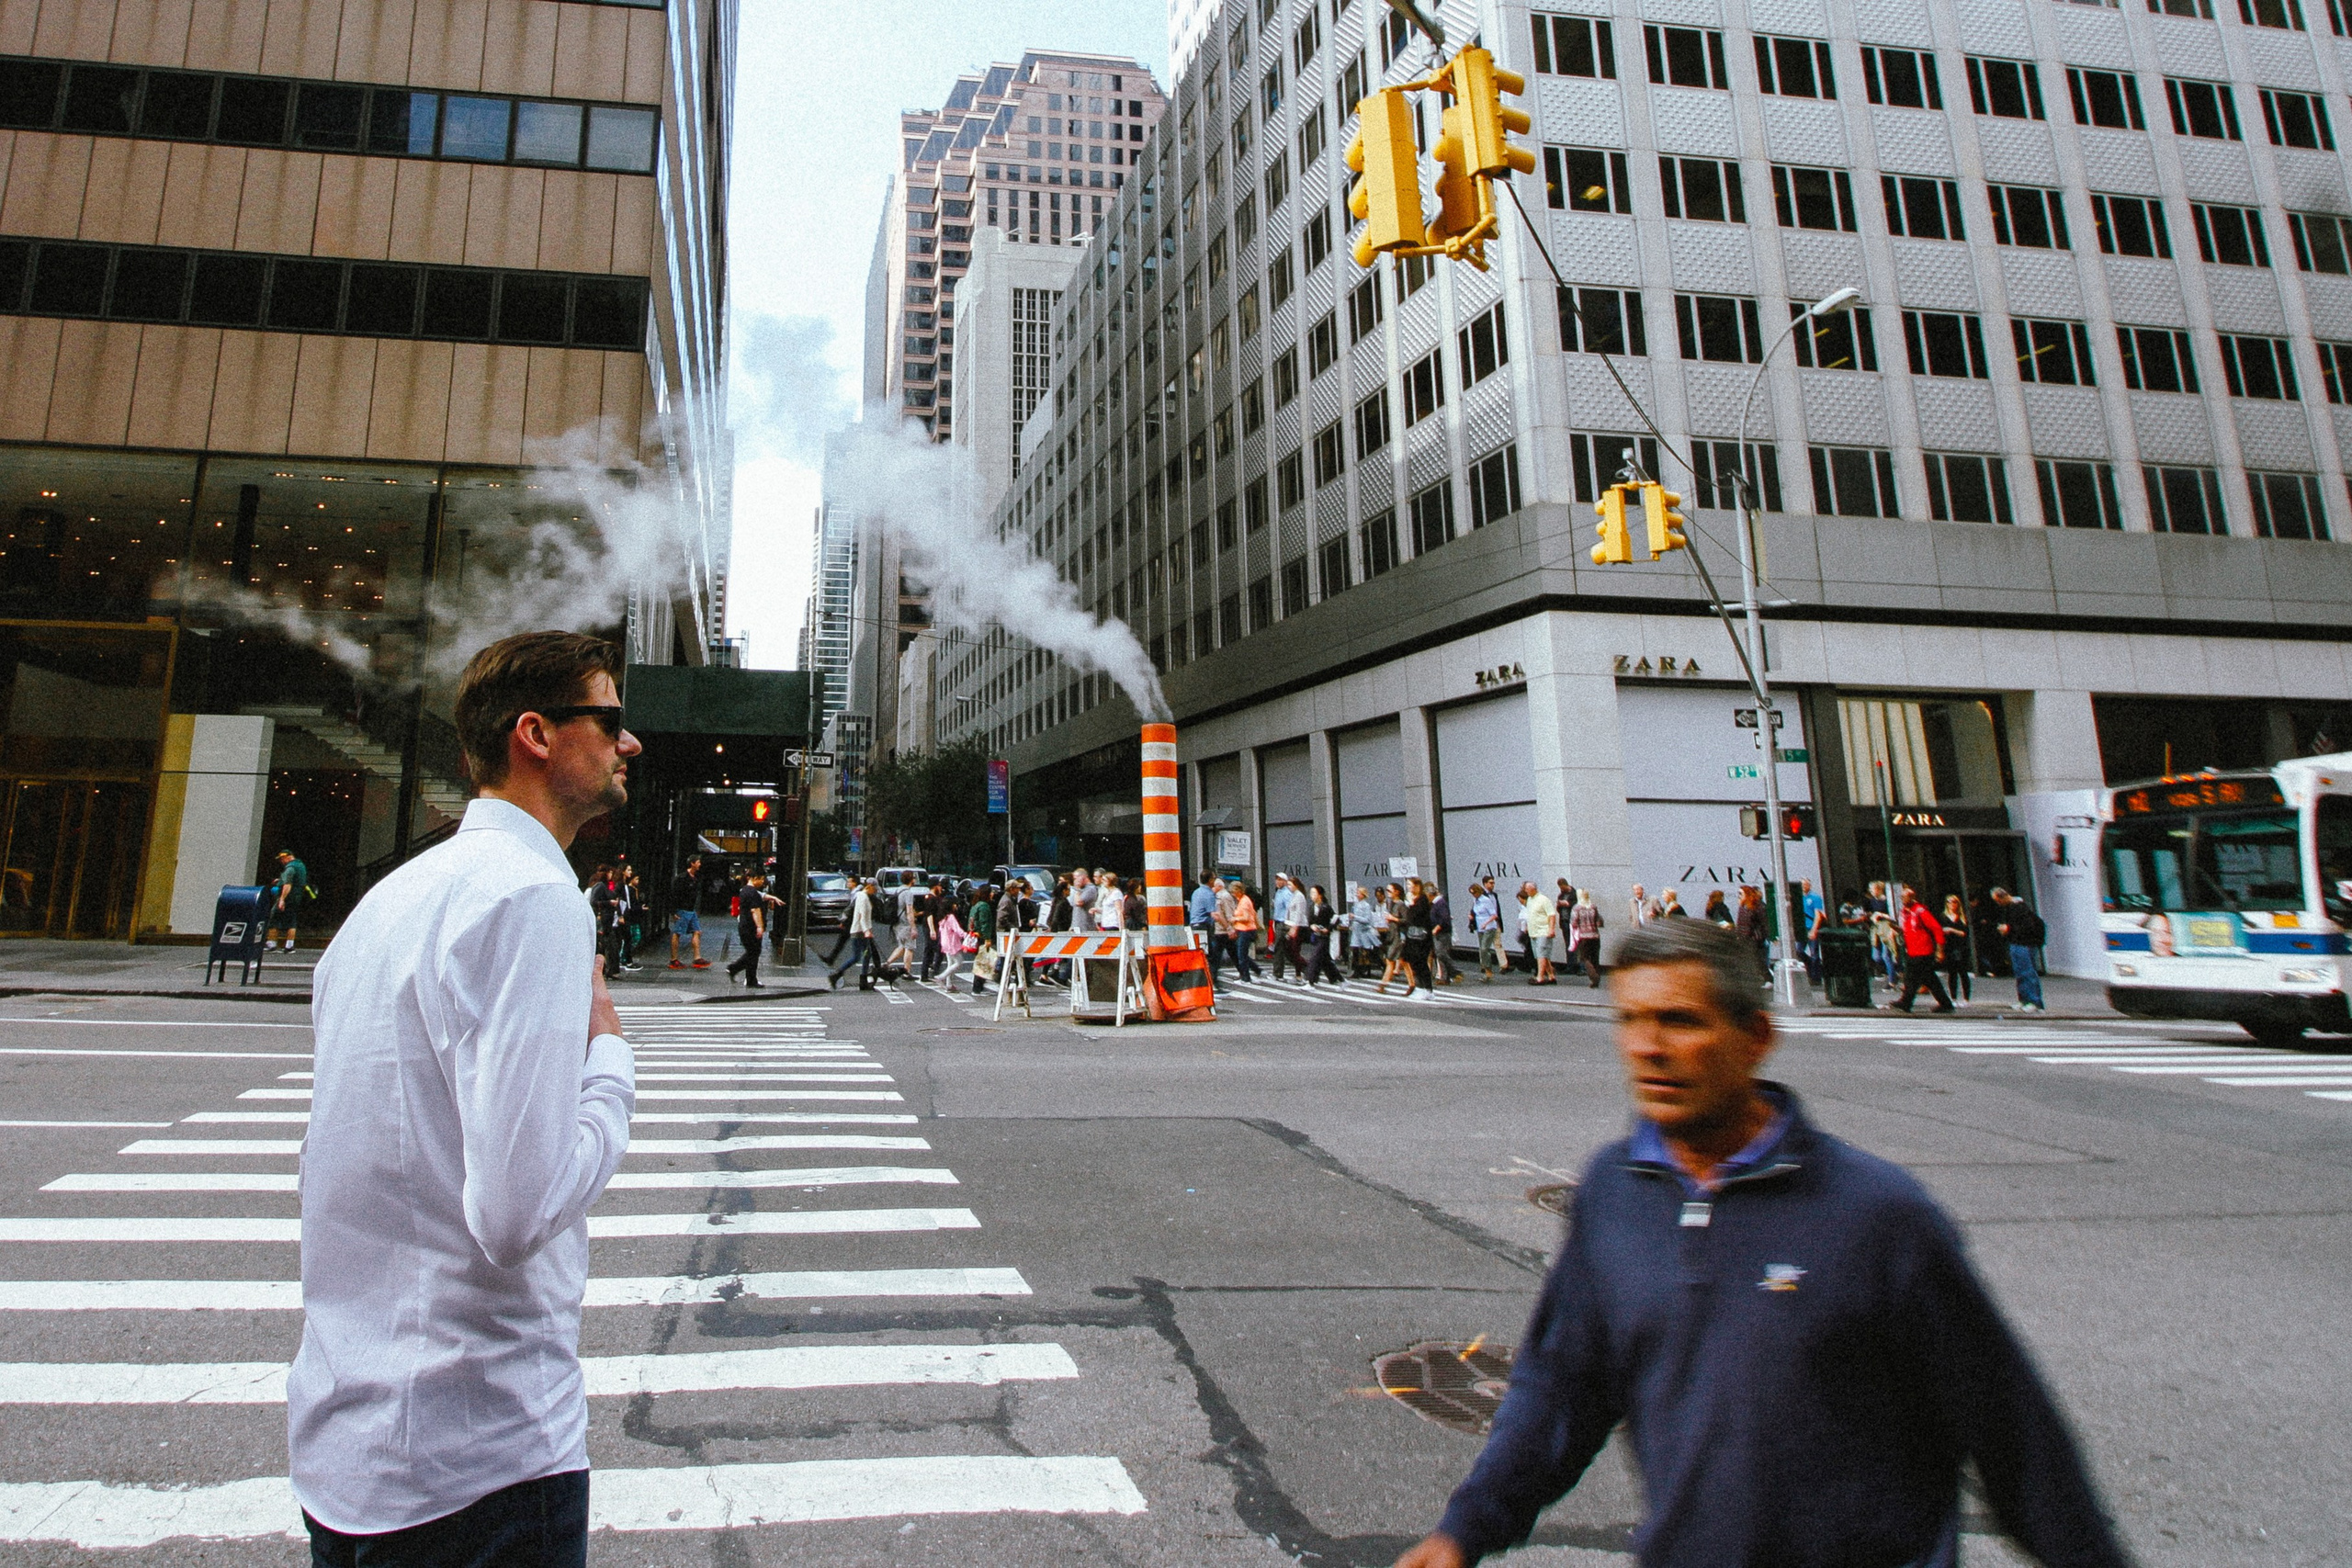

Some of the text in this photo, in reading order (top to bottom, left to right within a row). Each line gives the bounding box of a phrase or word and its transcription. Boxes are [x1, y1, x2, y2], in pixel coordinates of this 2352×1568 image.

[1613, 655, 1701, 672] ZARA
[1475, 661, 1525, 685] ZARA
[1892, 812, 1946, 826] ZARA
[1283, 863, 1309, 876] ZARA
[1363, 863, 1389, 876] ZAR
[1473, 862, 1521, 877] ZARA
[1679, 865, 1770, 883] ZARA
